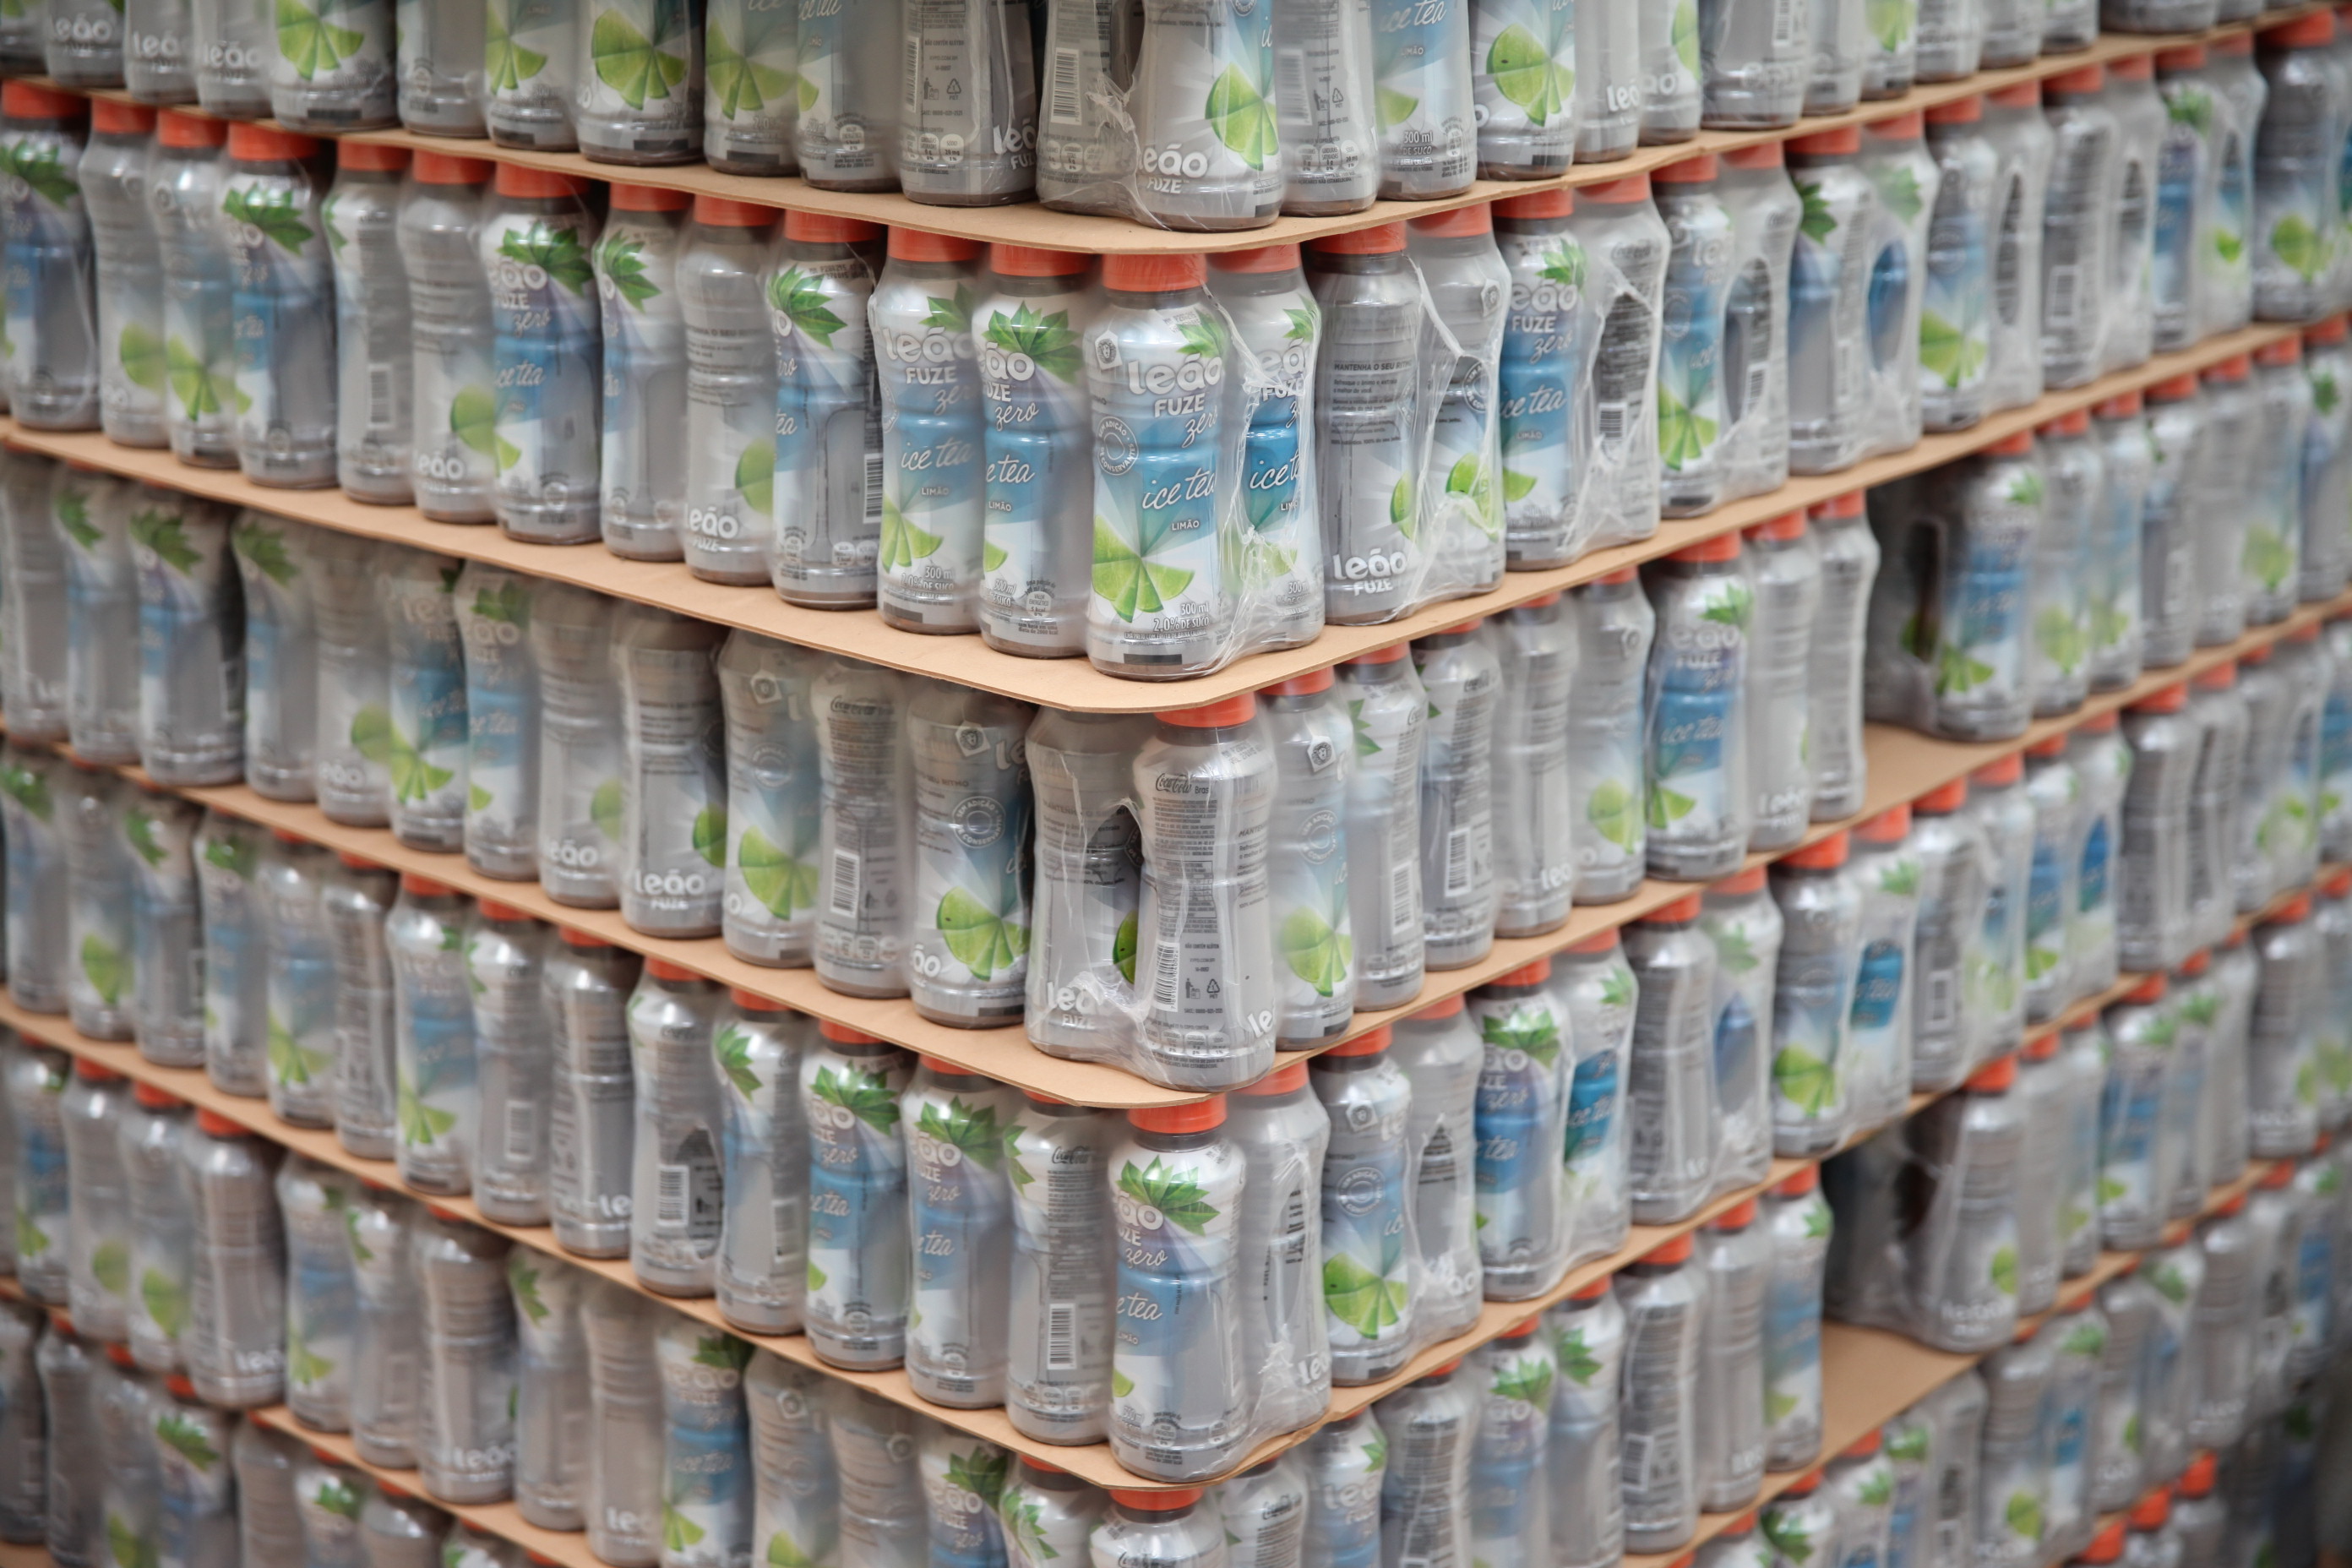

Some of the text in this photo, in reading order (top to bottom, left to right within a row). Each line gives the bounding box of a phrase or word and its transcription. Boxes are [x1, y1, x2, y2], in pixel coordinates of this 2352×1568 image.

[1403, 130, 1433, 144] 300 ml
[1403, 145, 1432, 155] DE SUCO
[1140, 144, 1207, 178] eão
[1147, 177, 1183, 194] FUZE
[1511, 315, 1556, 333] FUZE
[906, 367, 958, 384] FUZE
[1128, 353, 1222, 395] leão
[1154, 393, 1206, 417] FUZE
[1528, 384, 1566, 415] tea
[994, 403, 1040, 432] zero
[1105, 421, 1127, 436] ADIÇÃO
[901, 437, 972, 471] ice tea
[997, 455, 1036, 484] tea
[1250, 459, 1289, 490] ice
[921, 487, 950, 497] LIMÃO
[1142, 467, 1217, 509] ice tea
[988, 501, 1012, 512] LIMÃO
[1172, 520, 1200, 531] LIMÃO
[925, 566, 941, 580] 300
[1333, 549, 1407, 580] leão
[994, 579, 1008, 593] 300
[1288, 580, 1302, 593] 300
[1353, 579, 1394, 596] FUZE
[1181, 602, 1209, 615] 300 ml
[1153, 616, 1209, 632] 2,0% DE SUCO
[1156, 773, 1191, 793] Coca-Cola
[967, 799, 995, 811] ADIÇÃO
[634, 868, 705, 896] leão
[925, 1230, 956, 1257] tea
[1125, 1248, 1168, 1269] zero
[1127, 1292, 1163, 1320] tea
